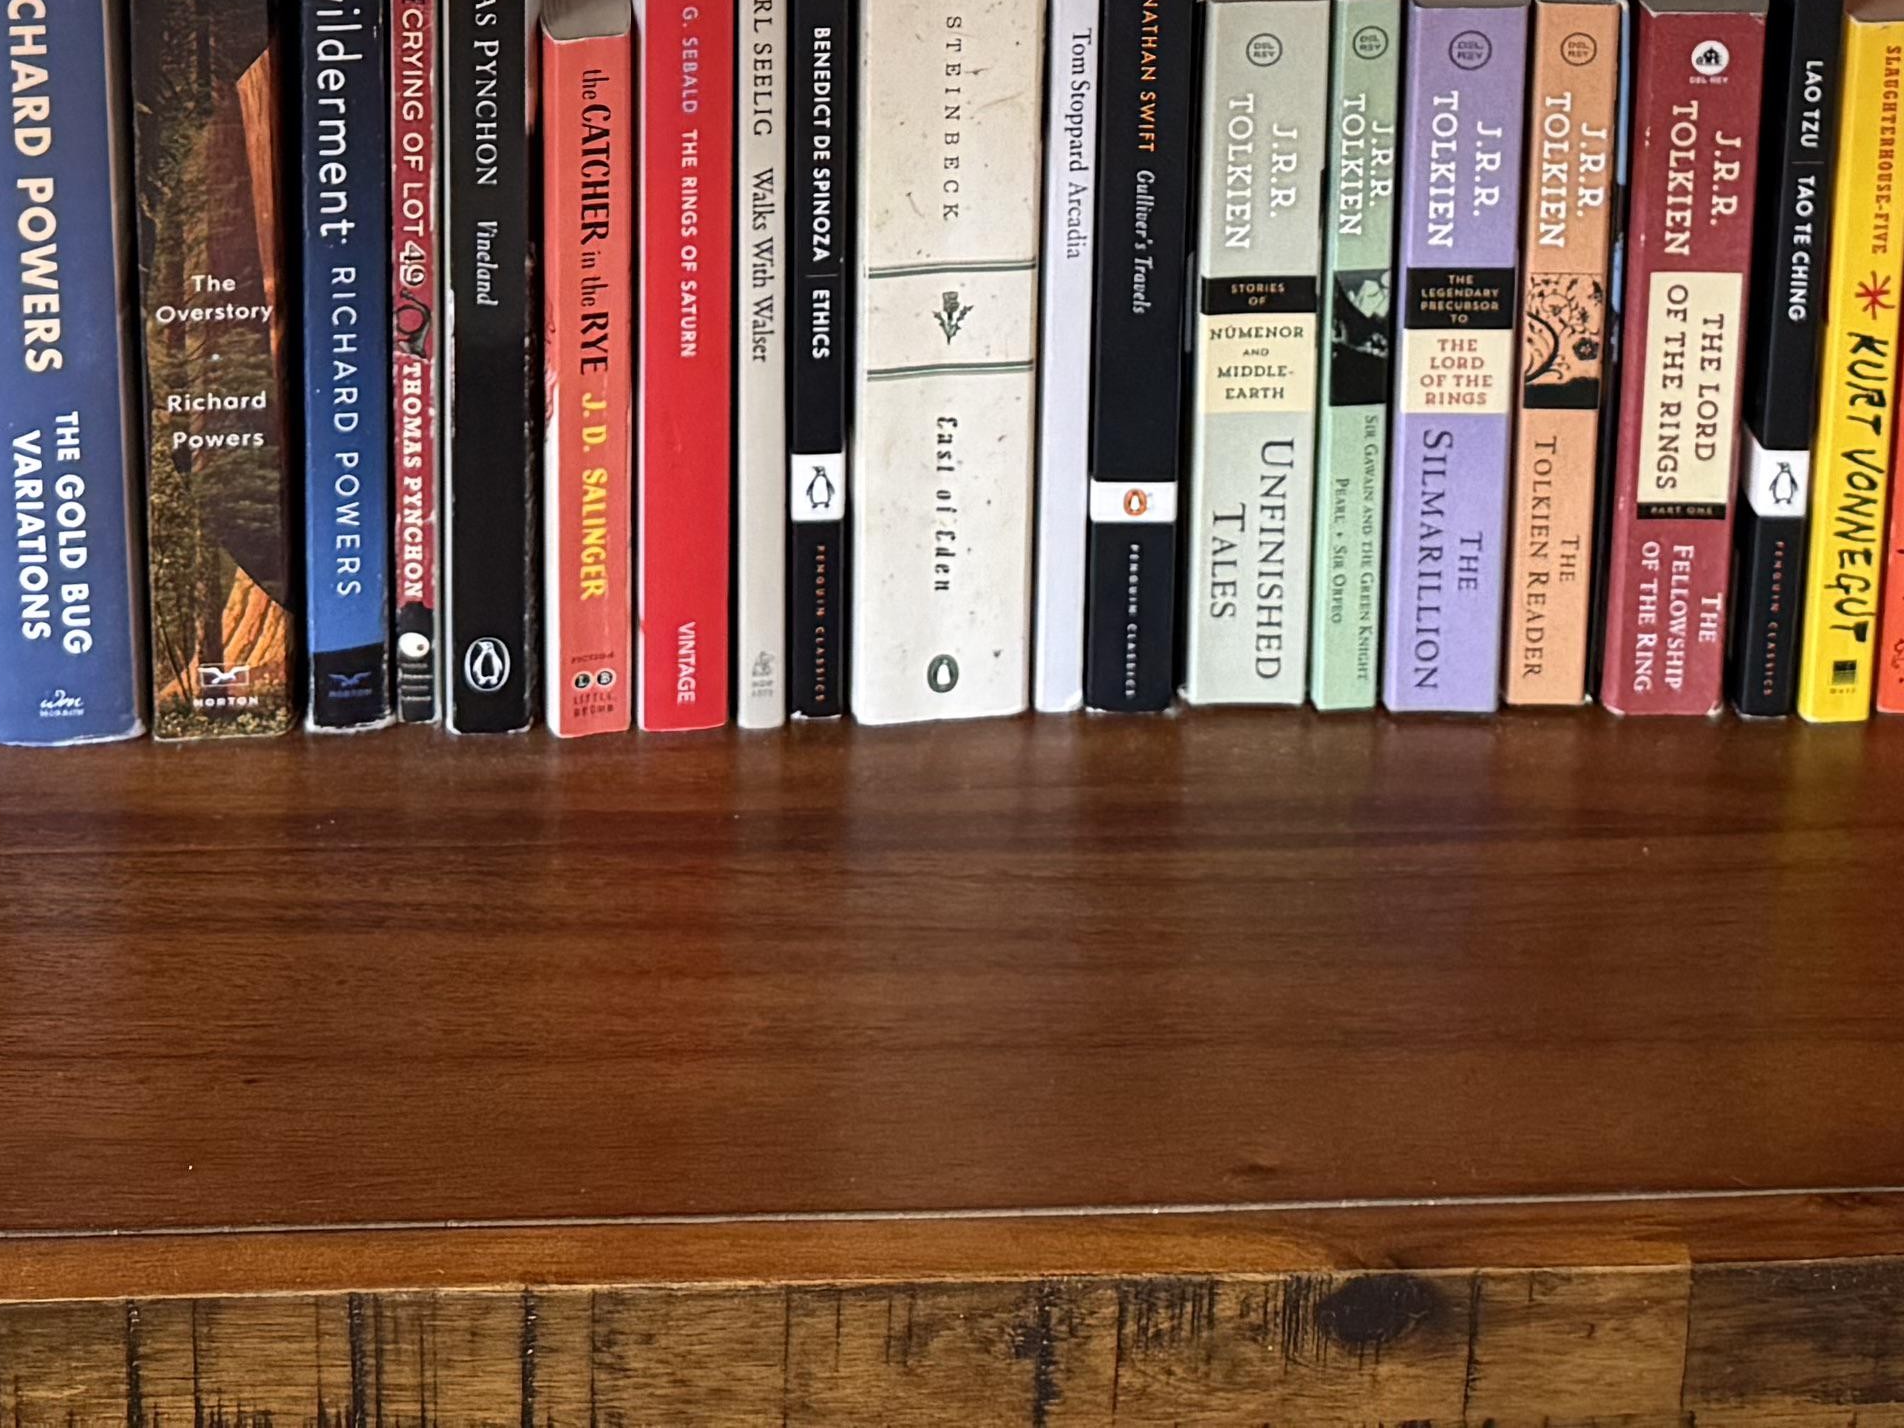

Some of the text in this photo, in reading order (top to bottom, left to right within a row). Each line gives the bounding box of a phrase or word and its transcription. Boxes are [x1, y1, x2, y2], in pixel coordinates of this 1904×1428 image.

[941, 16, 964, 222] STEINBECK
[1225, 94, 1255, 249] TOLKIEN
[1271, 123, 1297, 219] J.R.R.
[811, 26, 832, 360] BENEDICT DE SPINOZA ETHICS
[17, 176, 64, 374] POWERS
[155, 303, 274, 325] Overstory
[191, 274, 236, 293] The
[1210, 323, 1305, 342] NÚMENOR
[1216, 365, 1295, 380] MIDDLE-
[166, 390, 267, 412] Richard
[172, 428, 265, 448] Powers
[1224, 385, 1285, 400] EARTH
[11, 429, 51, 642] VARIATIONS
[54, 410, 92, 656] THE GOLD BUG
[1210, 503, 1246, 620] TALES
[1254, 439, 1295, 682] UNFINISHED
